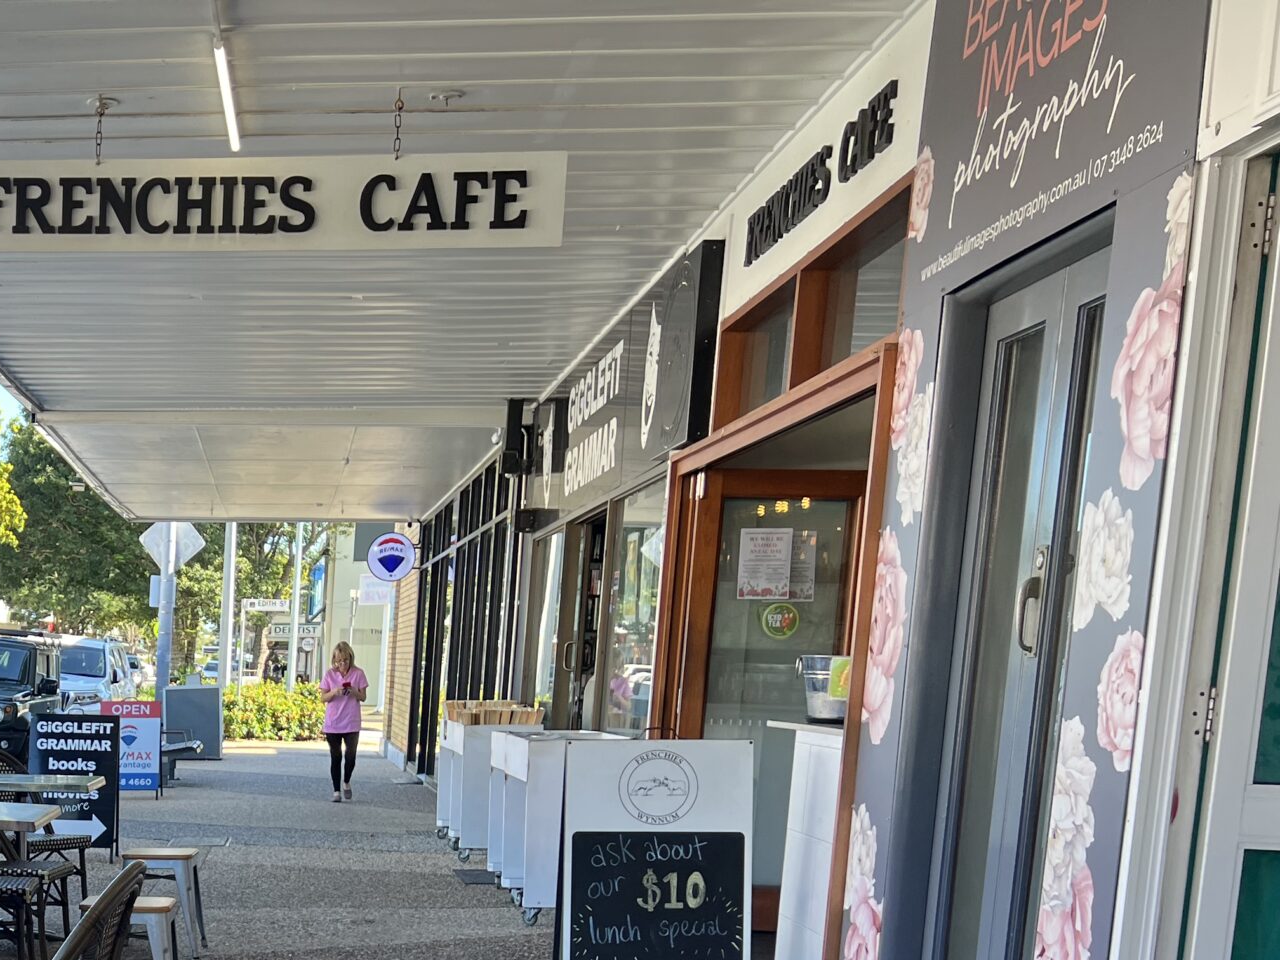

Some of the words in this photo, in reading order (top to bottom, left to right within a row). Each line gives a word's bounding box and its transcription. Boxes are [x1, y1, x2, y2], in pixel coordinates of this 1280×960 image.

[948, 14, 1136, 229] photography
[743, 145, 834, 267] FRENCHIES
[838, 79, 899, 184] CAFE
[359, 169, 529, 232] CAFE
[920, 168, 1087, 282] www.beautifulimagesphotography.com.au
[1093, 156, 1107, 179] 07
[1108, 136, 1135, 173] 3148
[1136, 120, 1165, 153] 2624
[564, 417, 618, 497] GRAMMAR
[274, 626, 318, 634] DETIST
[111, 704, 150, 715] OPEN
[36, 738, 112, 752] GRAMMAR
[48, 756, 97, 771] books
[634, 751, 684, 765] FRENCHIES
[128, 778, 152, 786] 4660
[61, 801, 90, 814] more
[637, 811, 680, 824] WYNNUM
[590, 834, 637, 868] ask
[645, 835, 708, 862] about
[587, 875, 626, 899] our
[636, 867, 707, 912] $10
[588, 914, 641, 945] lunch
[659, 914, 728, 948] special
